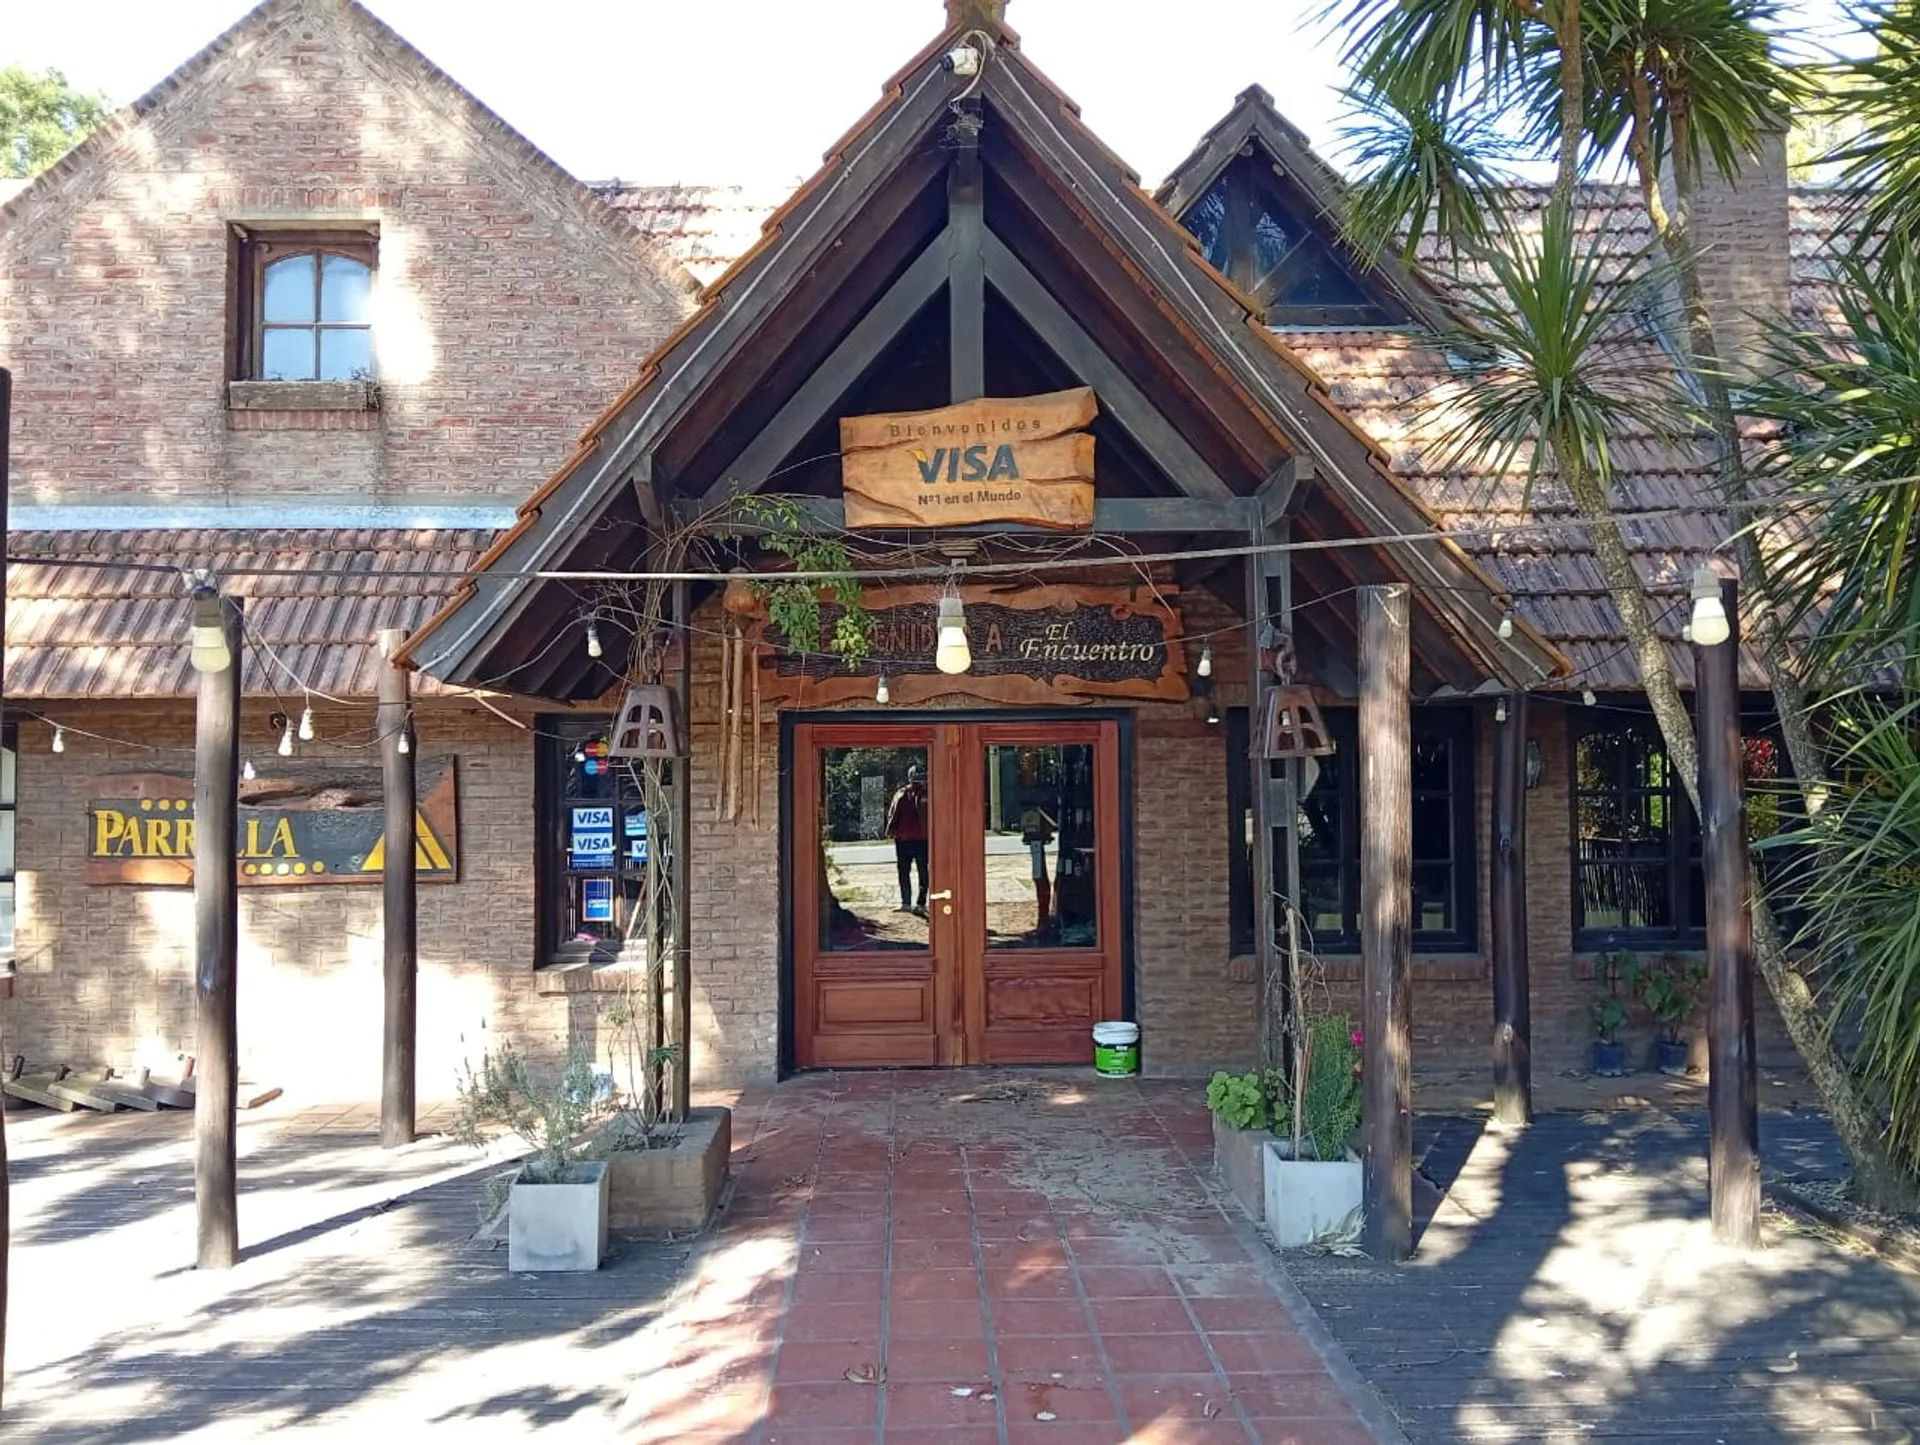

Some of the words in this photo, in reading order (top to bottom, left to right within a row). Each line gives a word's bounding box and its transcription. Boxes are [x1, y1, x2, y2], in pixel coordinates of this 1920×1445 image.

[890, 418, 1041, 437] Bienvenidos
[911, 444, 1021, 484] VISA
[945, 496, 960, 504] en
[963, 492, 973, 503] el
[978, 489, 1021, 503] Mundo
[986, 623, 1004, 653] A
[1046, 622, 1070, 641] El
[1019, 634, 1156, 662] Encuentro
[577, 811, 611, 823] VISA
[93, 809, 301, 859] PARRLA
[577, 837, 610, 850] VISA
